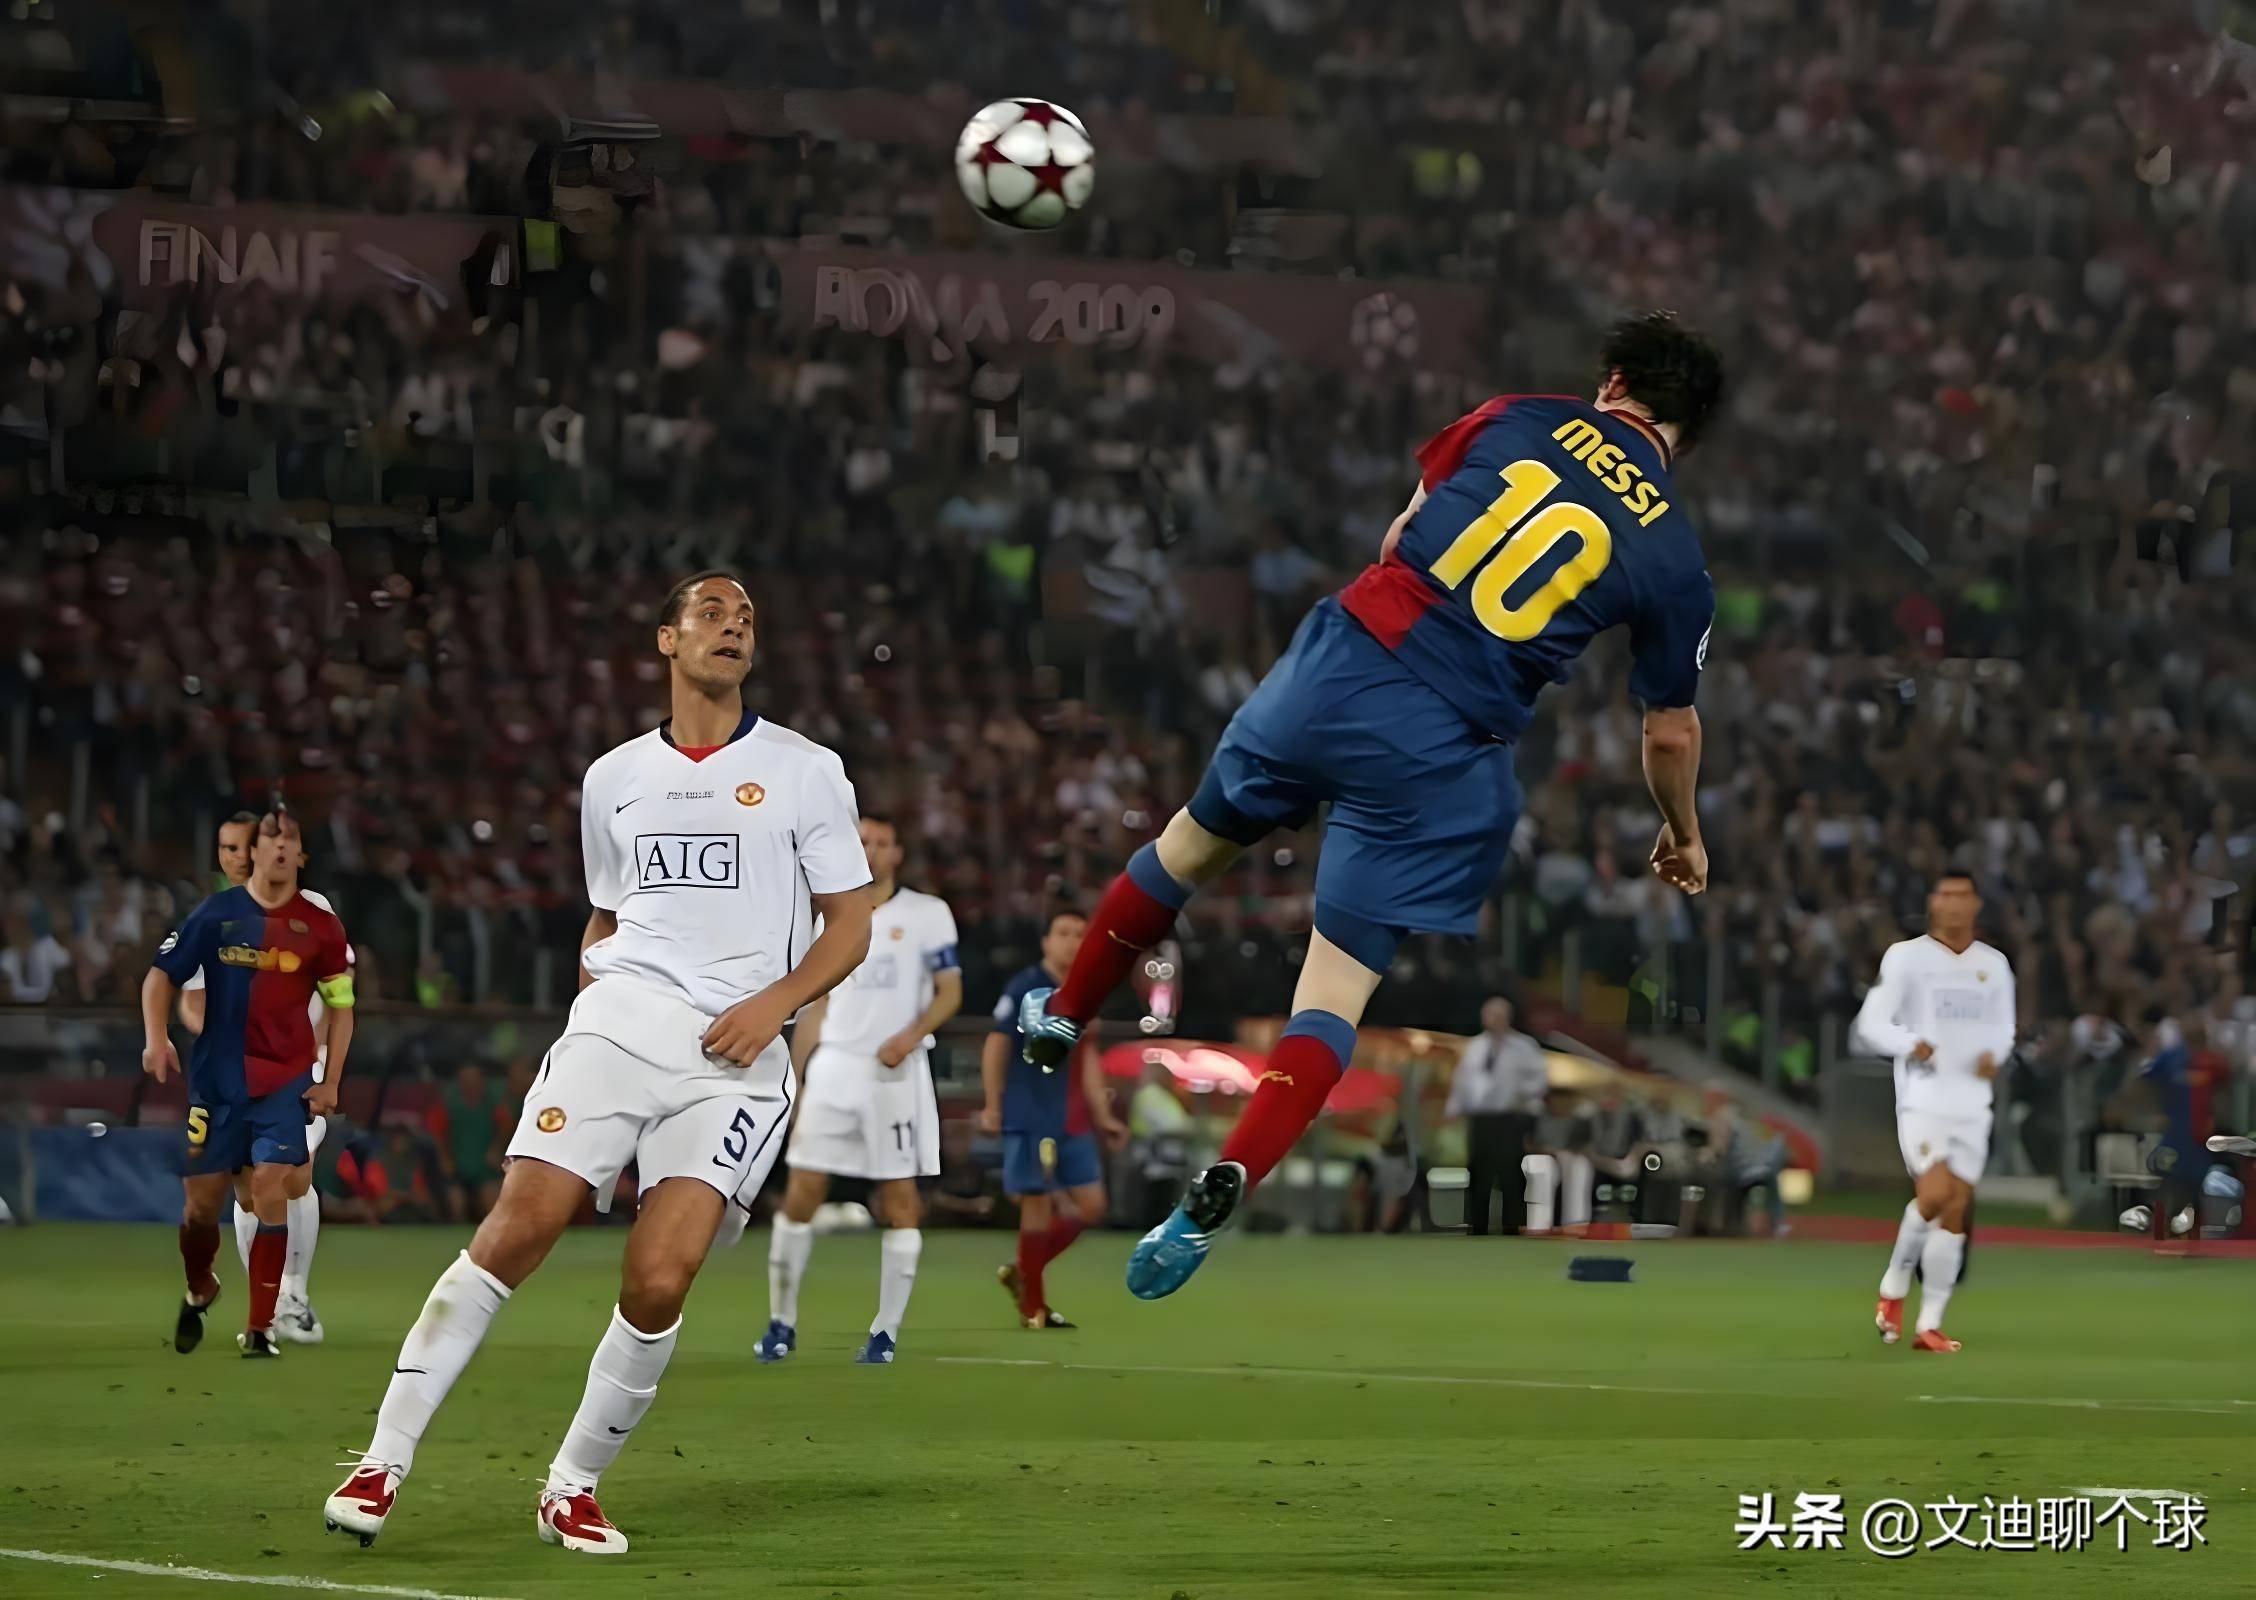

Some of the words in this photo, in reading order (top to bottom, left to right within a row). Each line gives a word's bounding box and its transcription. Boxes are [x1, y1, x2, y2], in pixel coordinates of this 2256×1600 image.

[1551, 418, 1670, 527] MESSI
[1429, 459, 1612, 642] 10
[643, 840, 733, 882] AIG
[187, 1106, 210, 1145] 5
[723, 1107, 755, 1163] 5
[891, 1120, 914, 1151] 11
